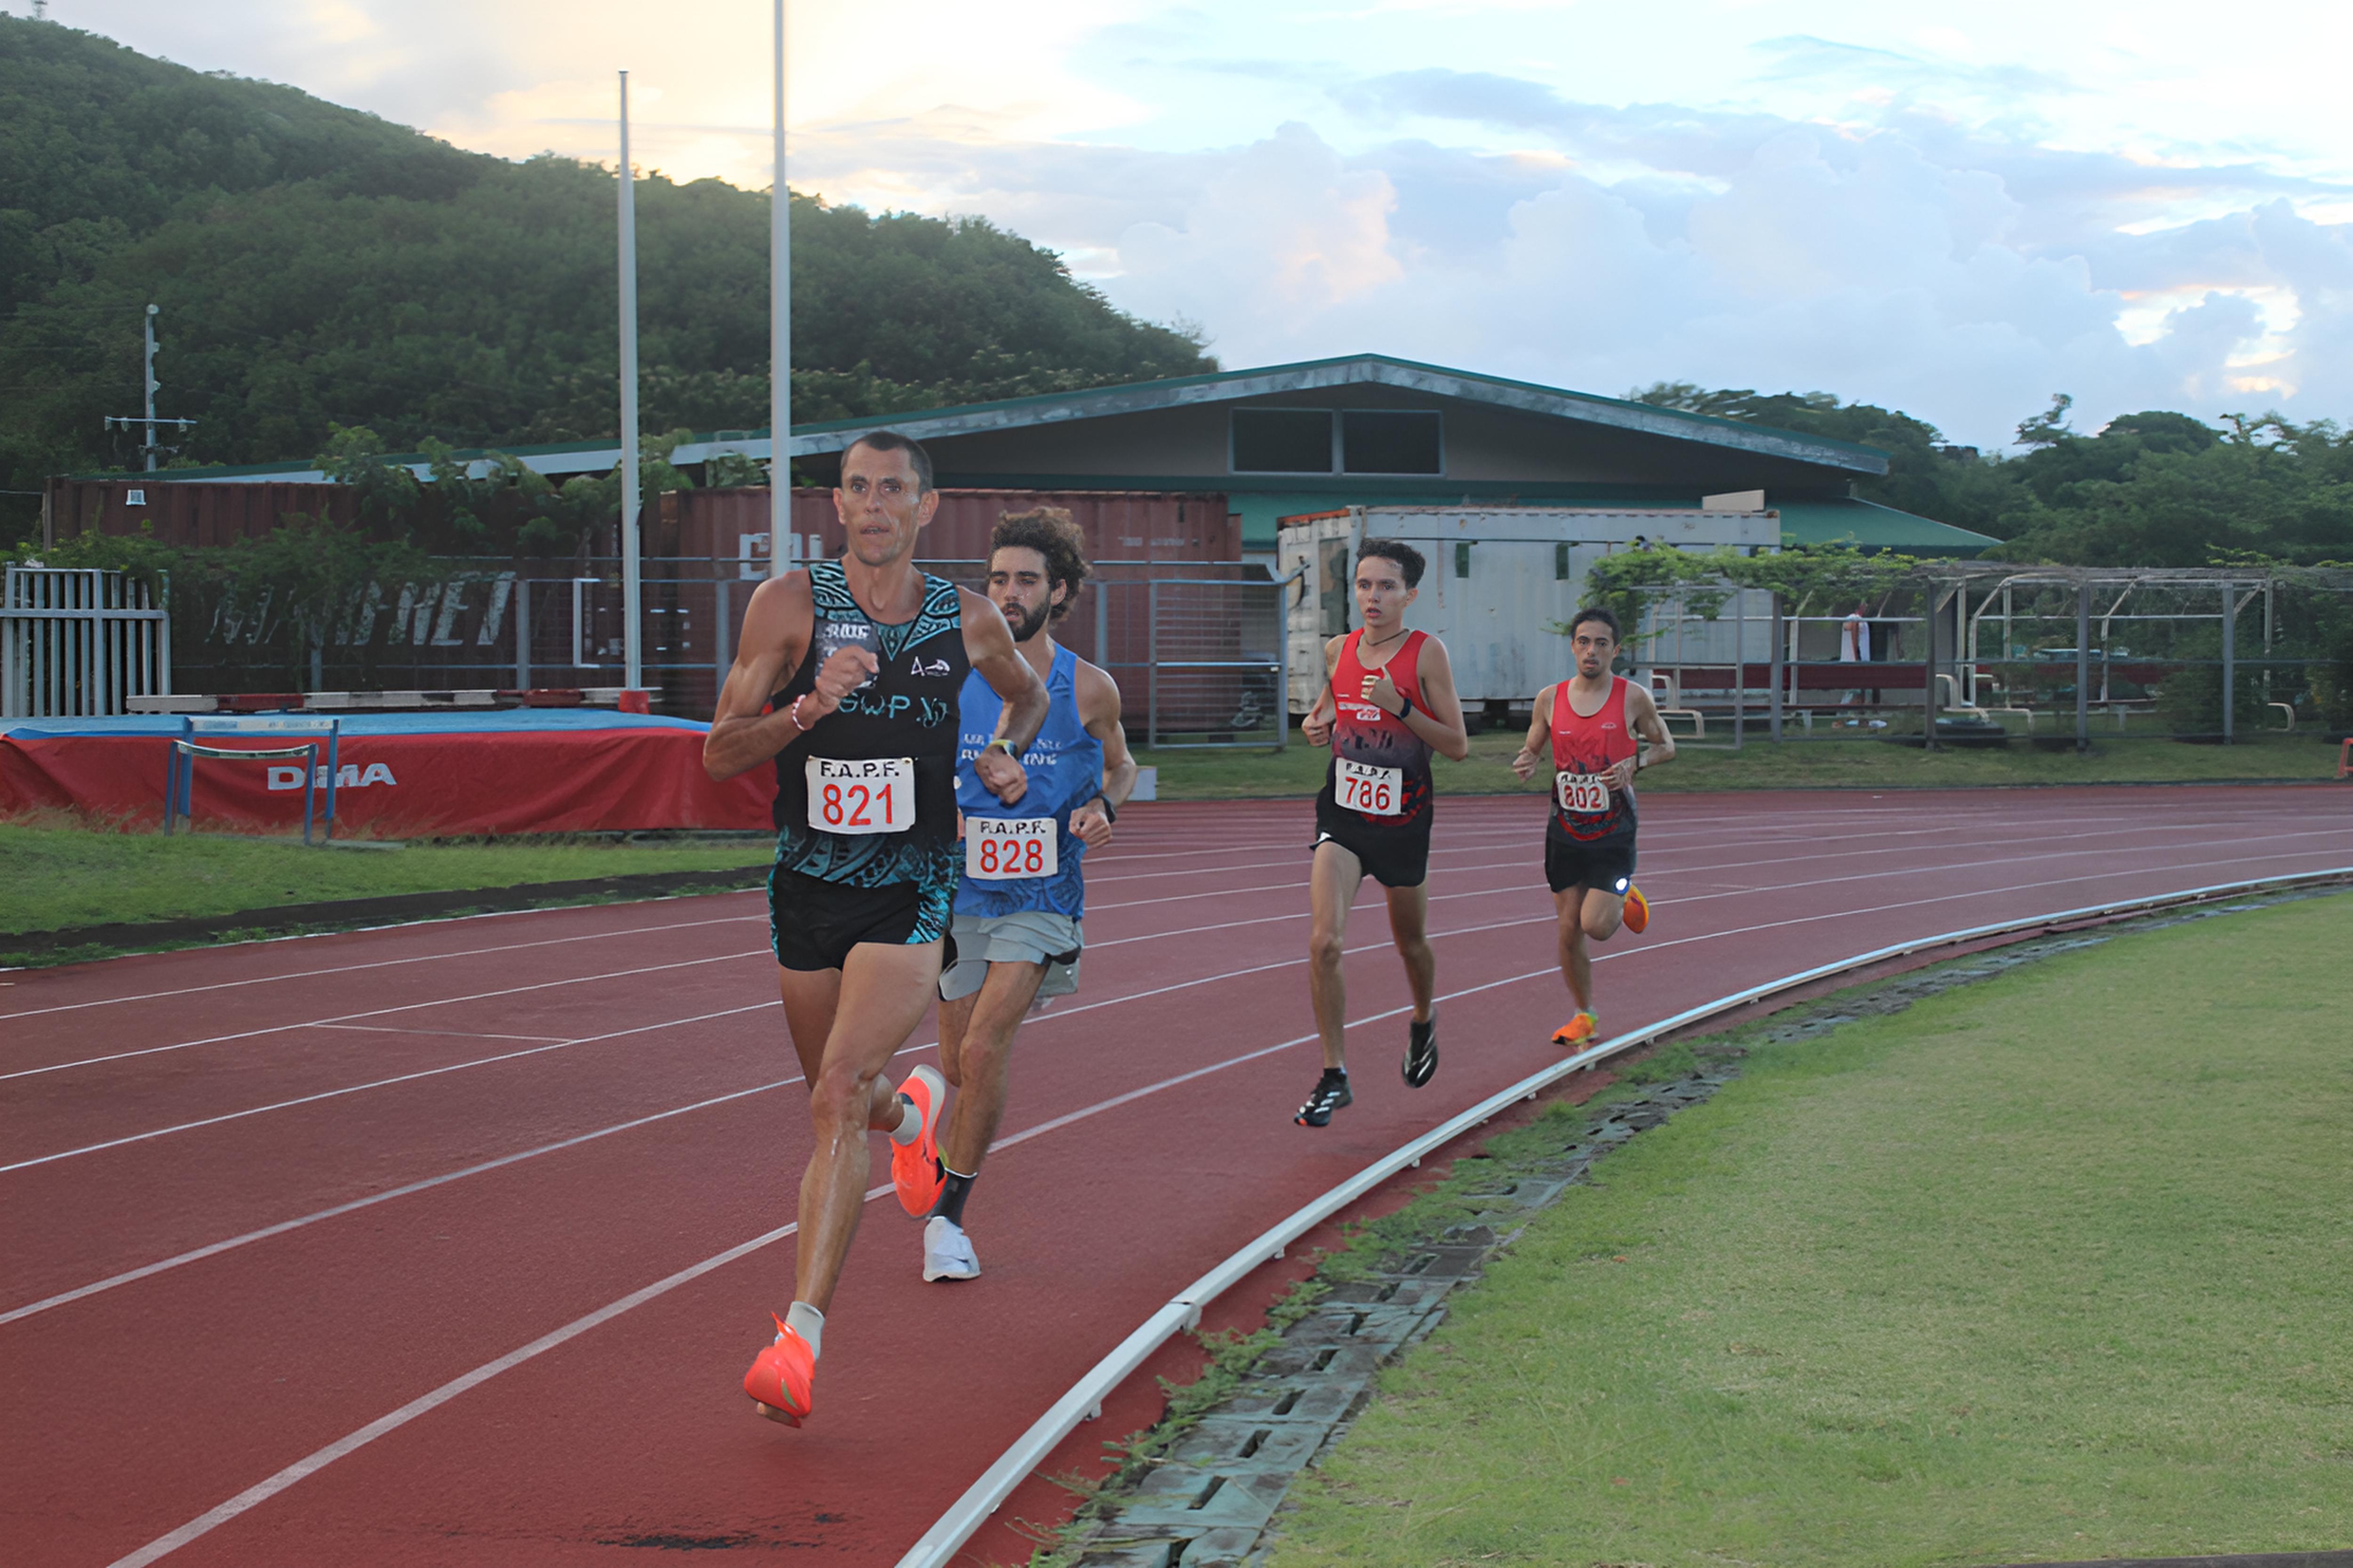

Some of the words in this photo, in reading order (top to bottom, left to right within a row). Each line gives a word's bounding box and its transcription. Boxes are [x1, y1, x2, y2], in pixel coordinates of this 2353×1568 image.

[821, 761, 900, 777] F.A.P.F.
[822, 784, 893, 826] 821
[980, 839, 1043, 873] 828
